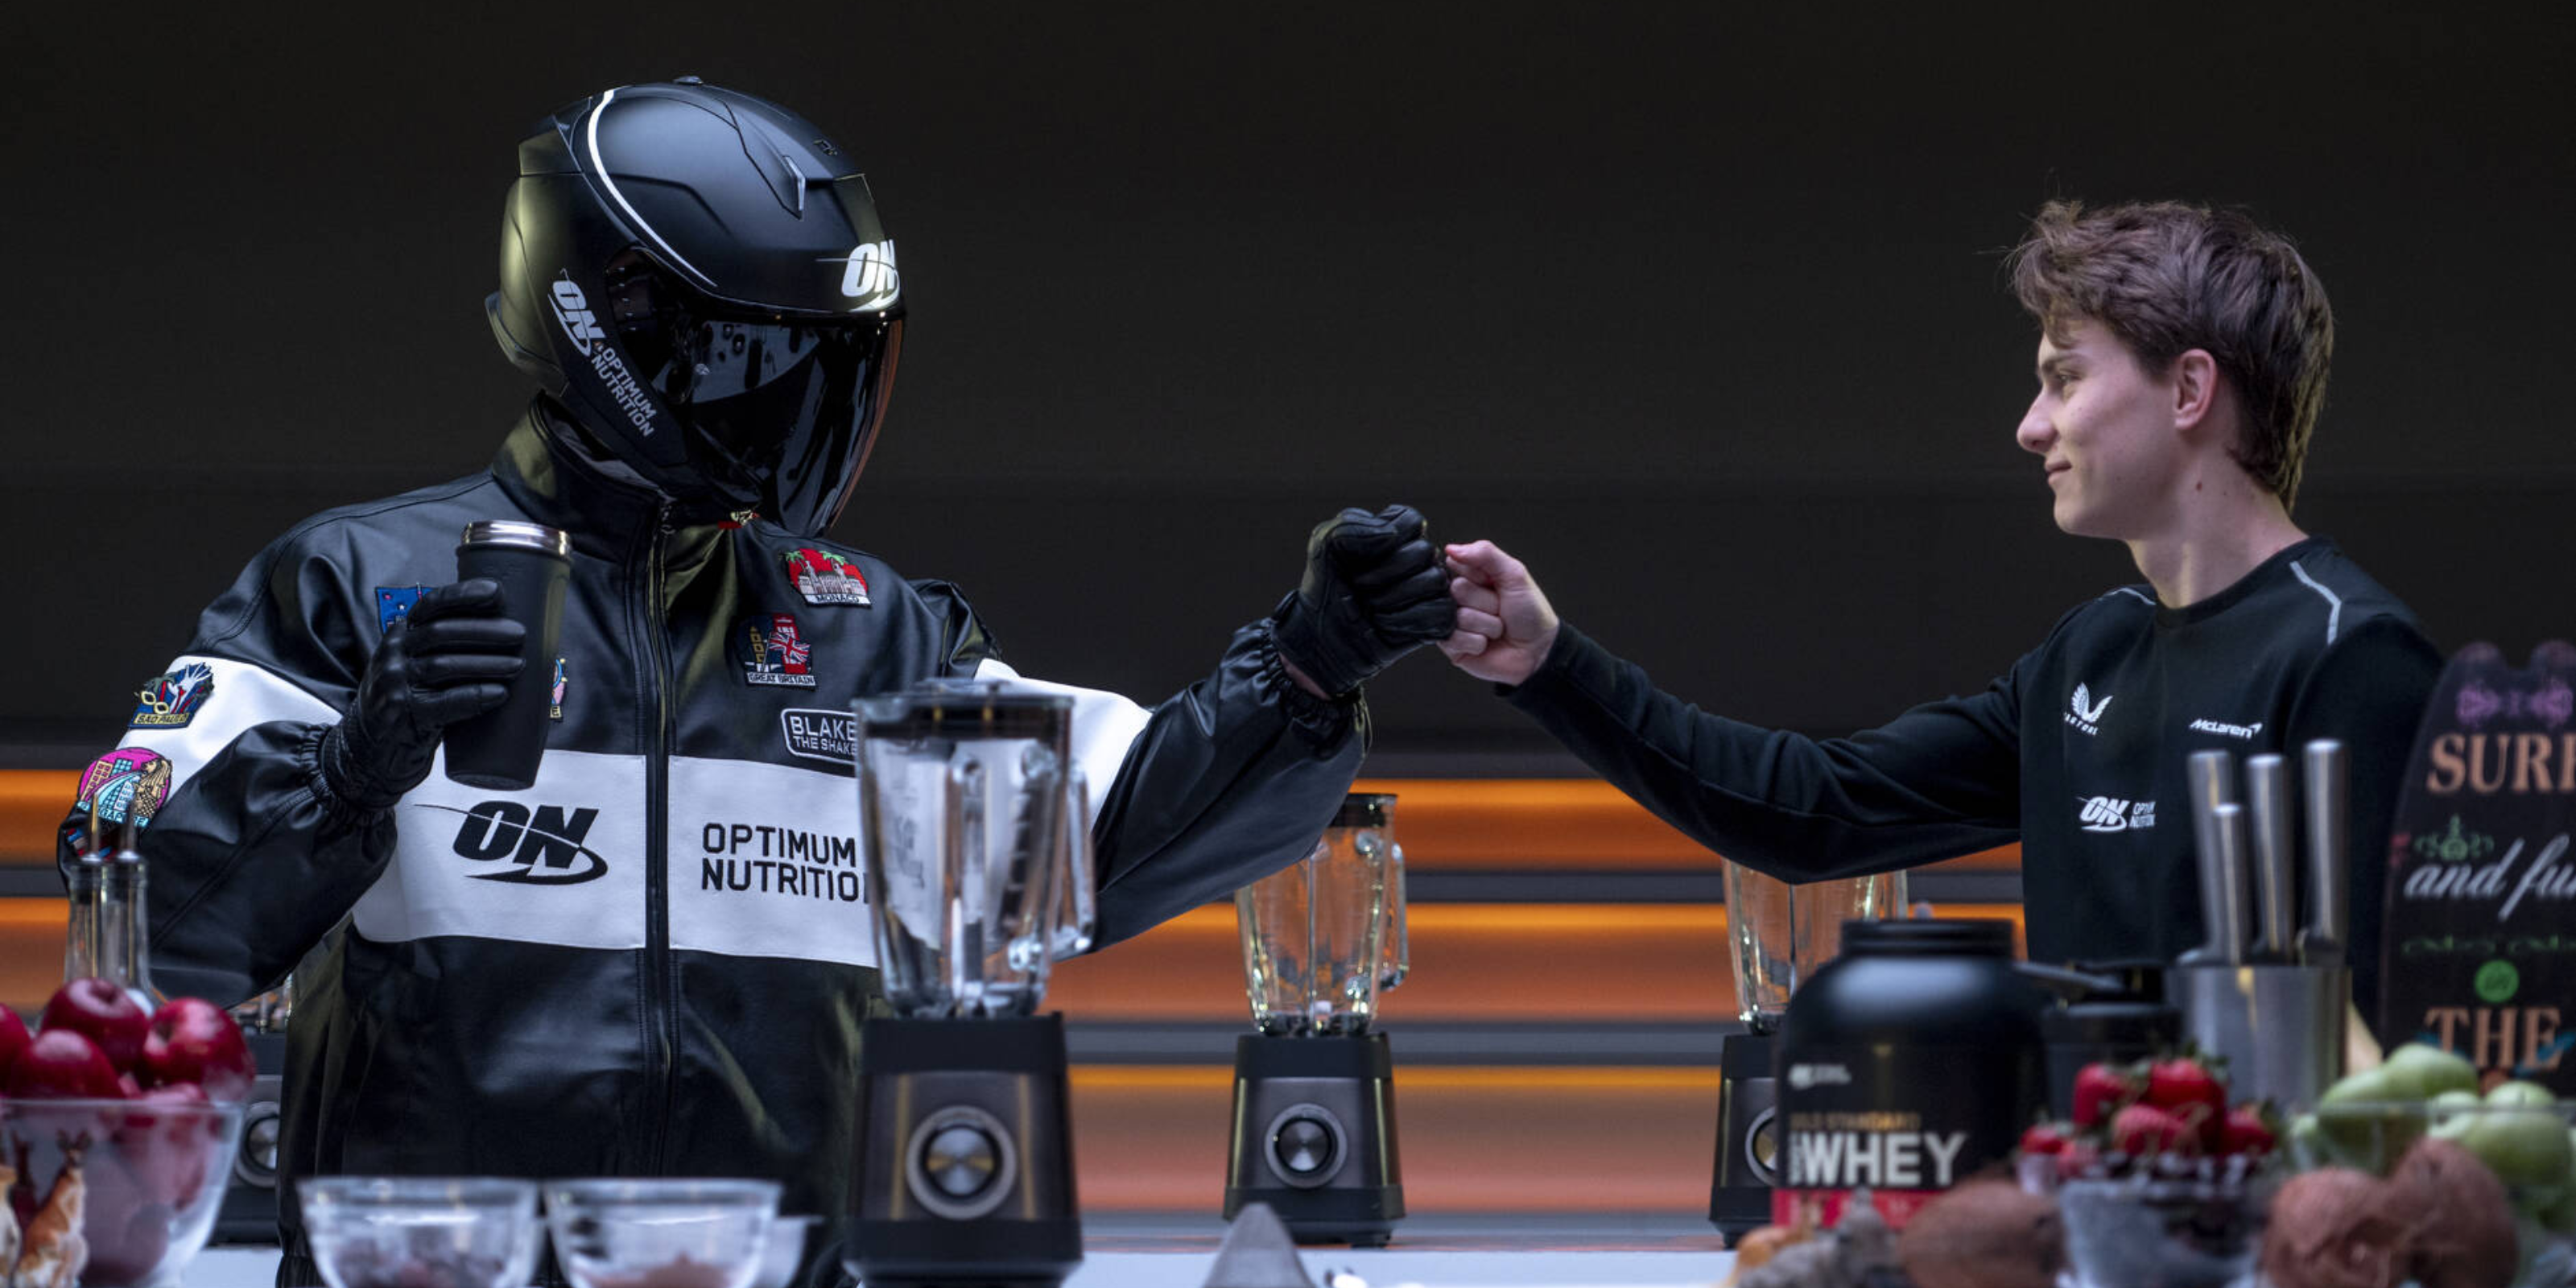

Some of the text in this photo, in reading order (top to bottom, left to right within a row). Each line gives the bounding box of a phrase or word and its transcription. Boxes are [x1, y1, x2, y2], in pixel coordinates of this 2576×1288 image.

[840, 238, 899, 301] ON
[551, 279, 606, 345] ON
[591, 354, 655, 437] NUTRITION
[602, 347, 658, 419] OPTIMUM
[815, 593, 861, 604] MONACO
[749, 672, 815, 684] GREAT BRITAIN
[789, 716, 857, 743] BLAKE
[792, 735, 819, 749] THE
[2190, 718, 2253, 740] McLaren
[452, 801, 601, 876] ON
[2079, 796, 2130, 828] ON
[702, 822, 857, 868] OPTIMUM
[2404, 834, 2576, 921] and fu
[2424, 1007, 2562, 1071] THE
[1801, 1131, 1967, 1187] WHEY
